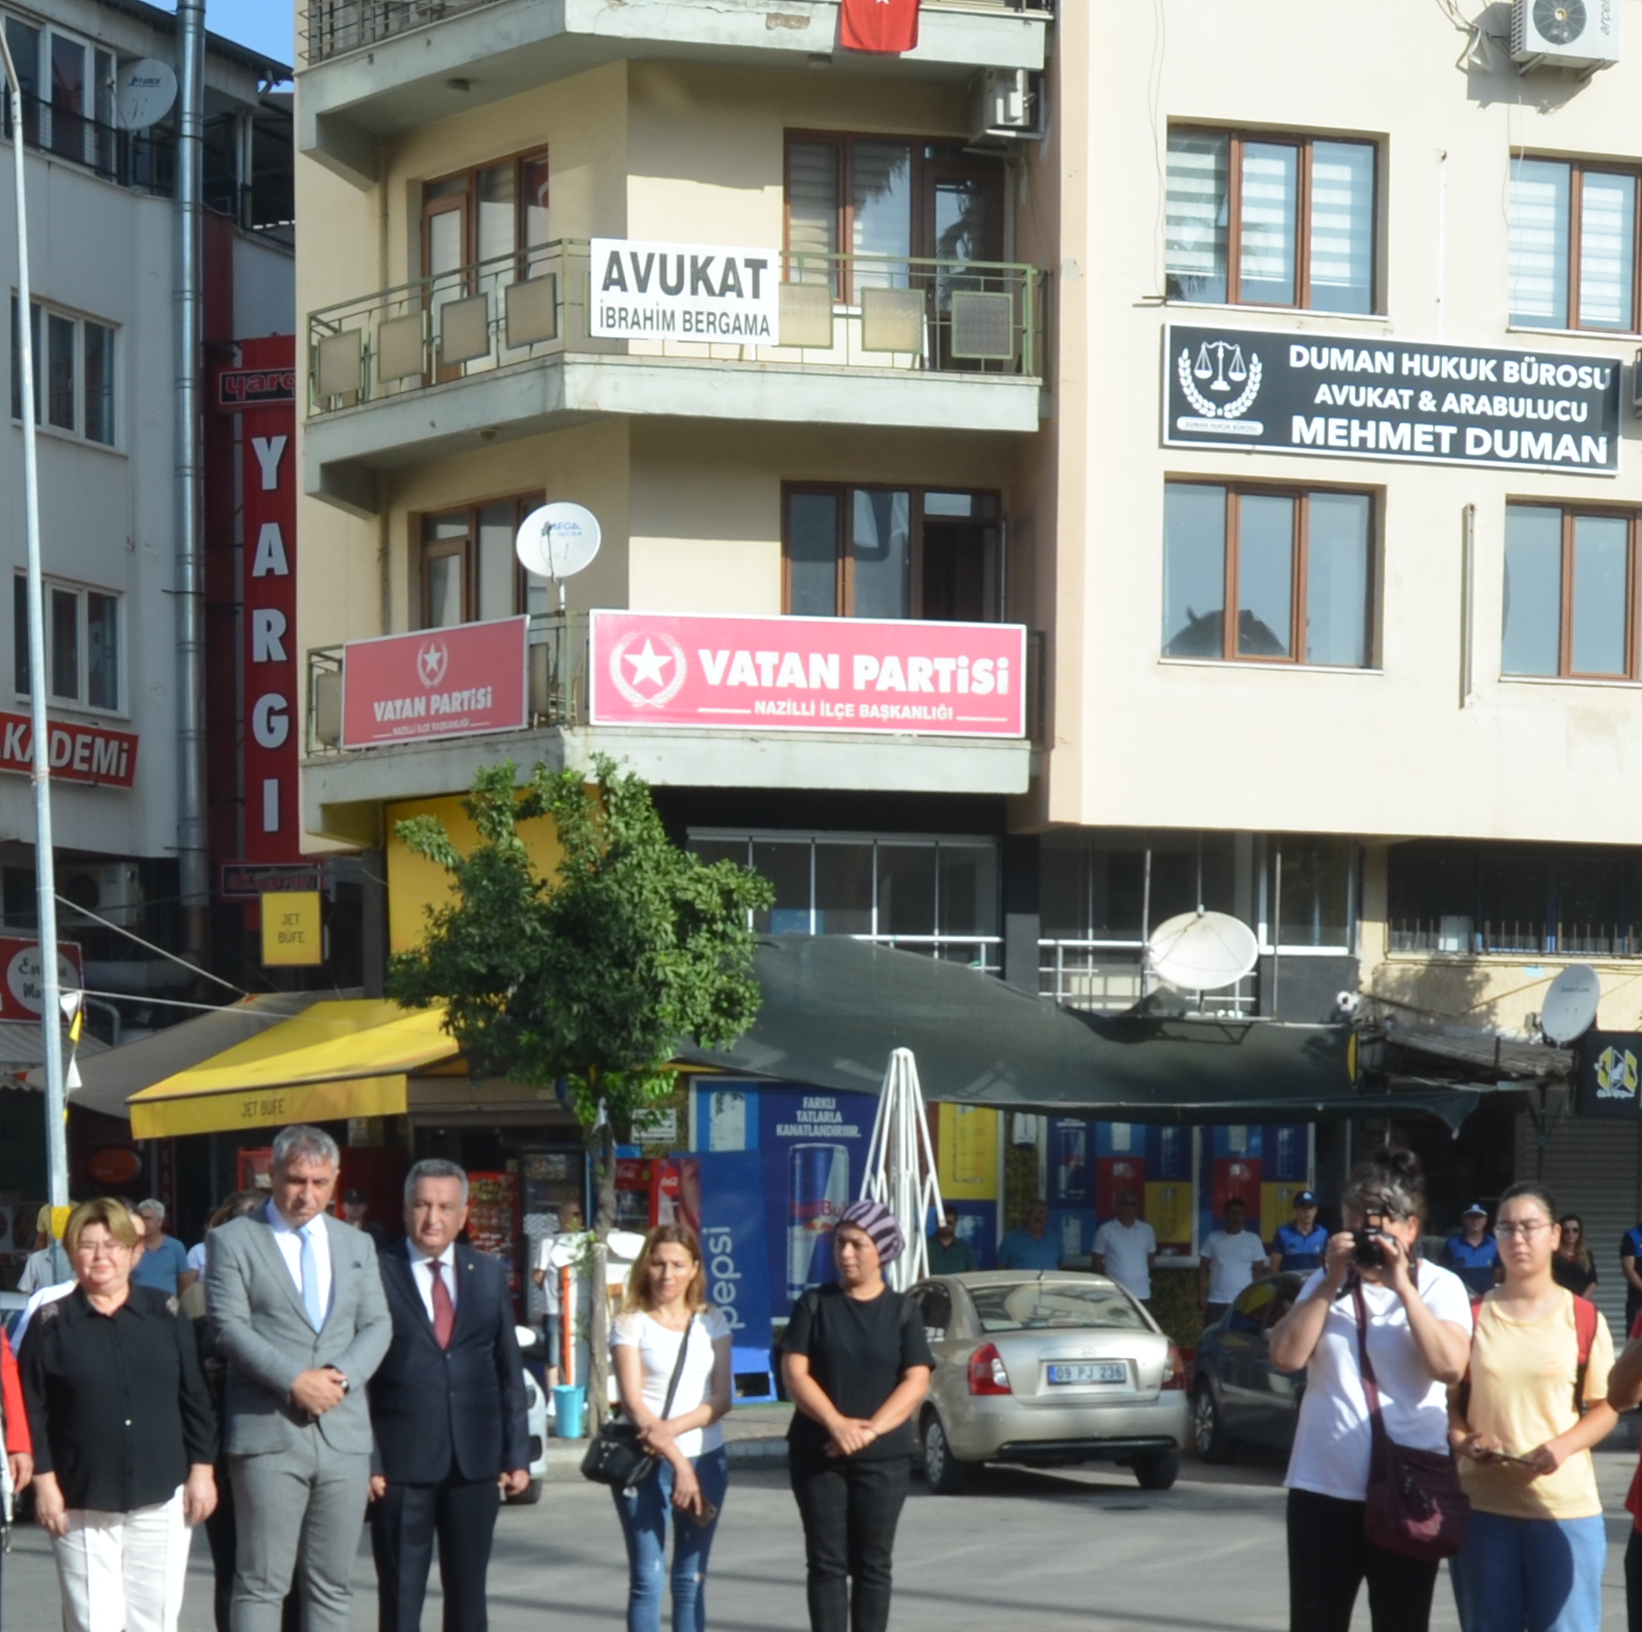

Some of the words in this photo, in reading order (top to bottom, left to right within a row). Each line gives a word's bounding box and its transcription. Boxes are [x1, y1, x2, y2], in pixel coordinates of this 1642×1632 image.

[602, 250, 768, 300] AVUKAT
[600, 299, 675, 332] İBRAHİM
[683, 310, 771, 337] BERGAMA
[1289, 344, 1395, 376] DUMAN
[1401, 352, 1497, 382] HUKUK
[1503, 356, 1612, 391] BÜROSU
[1314, 383, 1414, 411] AVUKAT
[1418, 390, 1438, 412] &
[1441, 393, 1589, 423] ARABULUCU
[1291, 415, 1457, 454] MEHMET
[1465, 426, 1608, 465] DUMAN
[251, 434, 289, 832] YARGI
[697, 648, 840, 690] VATAN
[373, 696, 427, 723] VATAN
[859, 703, 954, 723] BAŞKANLIĞI
[281, 912, 301, 926] JET
[241, 1100, 258, 1118] JET
[795, 1110, 844, 1124] TATLARLA
[802, 1096, 836, 1110] FARKLI
[703, 1226, 746, 1330] pepsi
[1057, 1367, 1073, 1381] 09
[1077, 1366, 1095, 1381] PJ
[1099, 1365, 1124, 1380] 236
